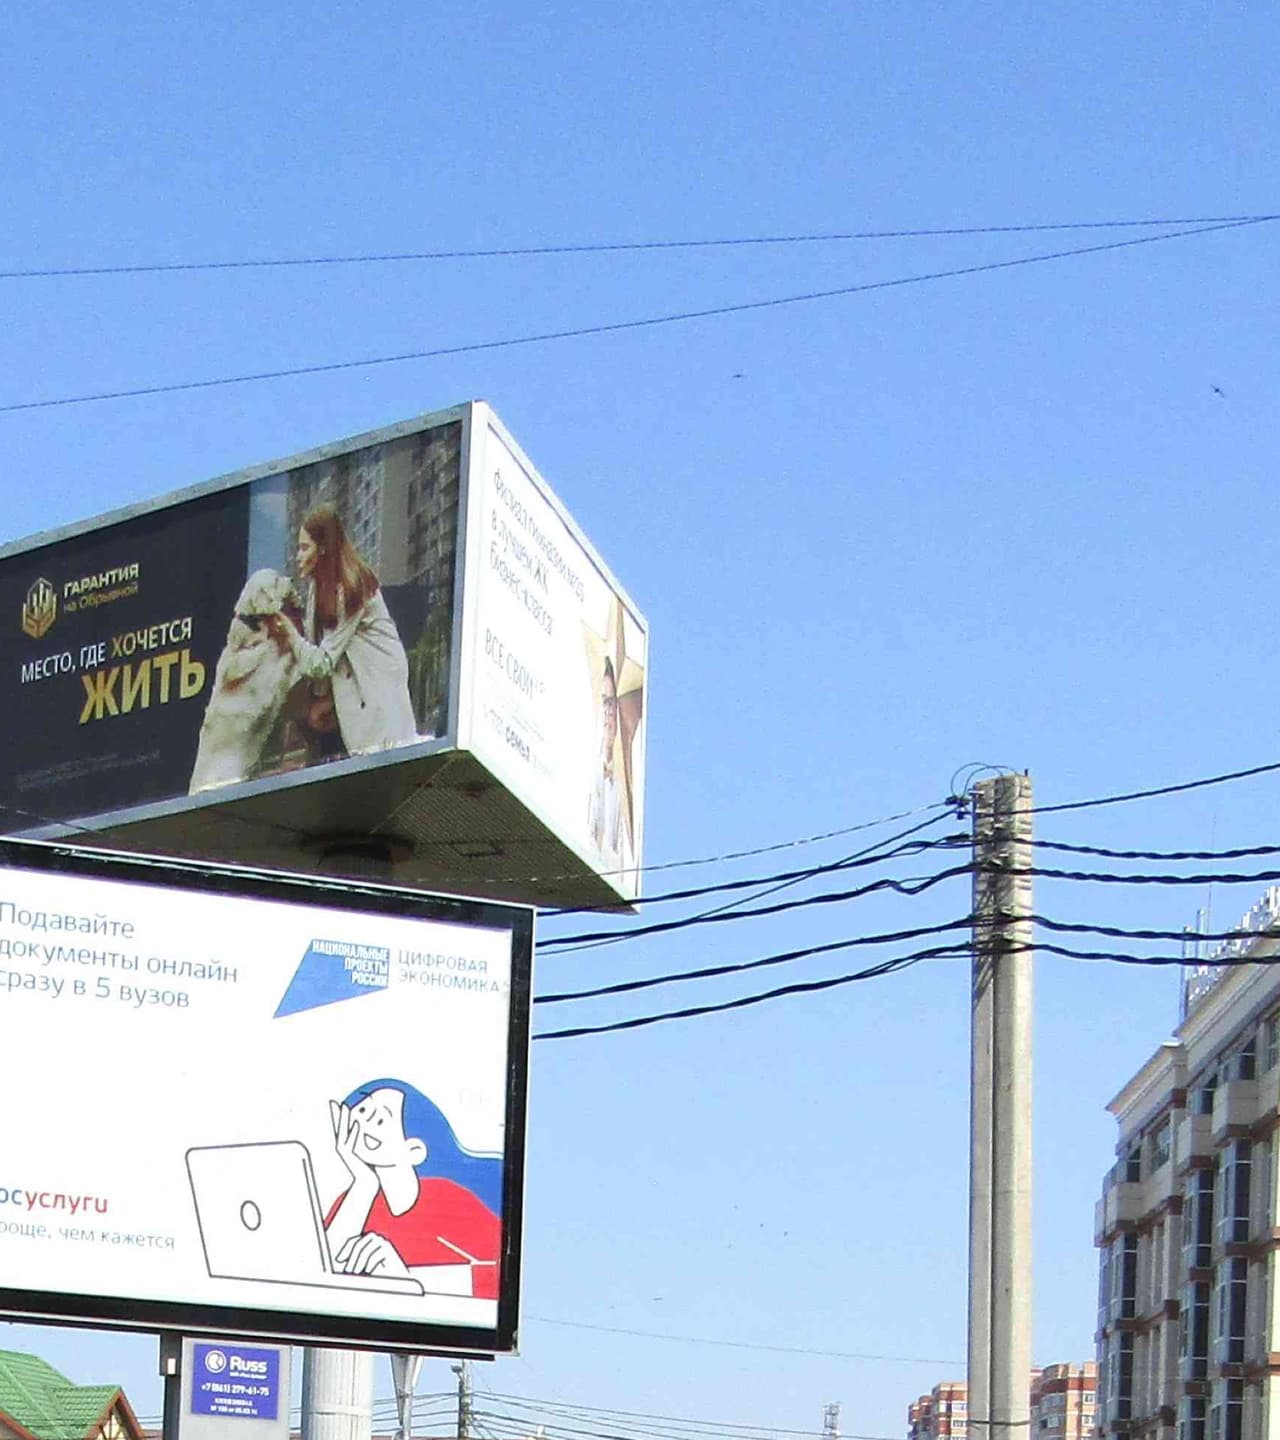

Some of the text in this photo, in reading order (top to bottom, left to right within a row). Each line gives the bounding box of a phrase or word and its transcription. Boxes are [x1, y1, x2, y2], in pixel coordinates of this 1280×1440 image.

[63, 562, 139, 599] ГАРАНТИЯ
[21, 616, 193, 684] МЕСТО, ГДЕ ХОЧЕТСЯ
[78, 648, 206, 725] ЖИТЬ
[312, 940, 388, 961] НАЦИОНАЛЬНЫЕ
[398, 949, 488, 972] ЦИФРОВАЯ
[146, 956, 238, 983] онлайн
[344, 957, 388, 974] ПРОЕКТЫ
[351, 971, 387, 986] РОССИИ
[399, 969, 499, 992] ЭКОНОМИКА
[73, 979, 86, 996] в
[95, 976, 111, 998] 5
[119, 984, 190, 1008] вузов
[58, 1227, 95, 1242] чем
[101, 1230, 175, 1249] кажется
